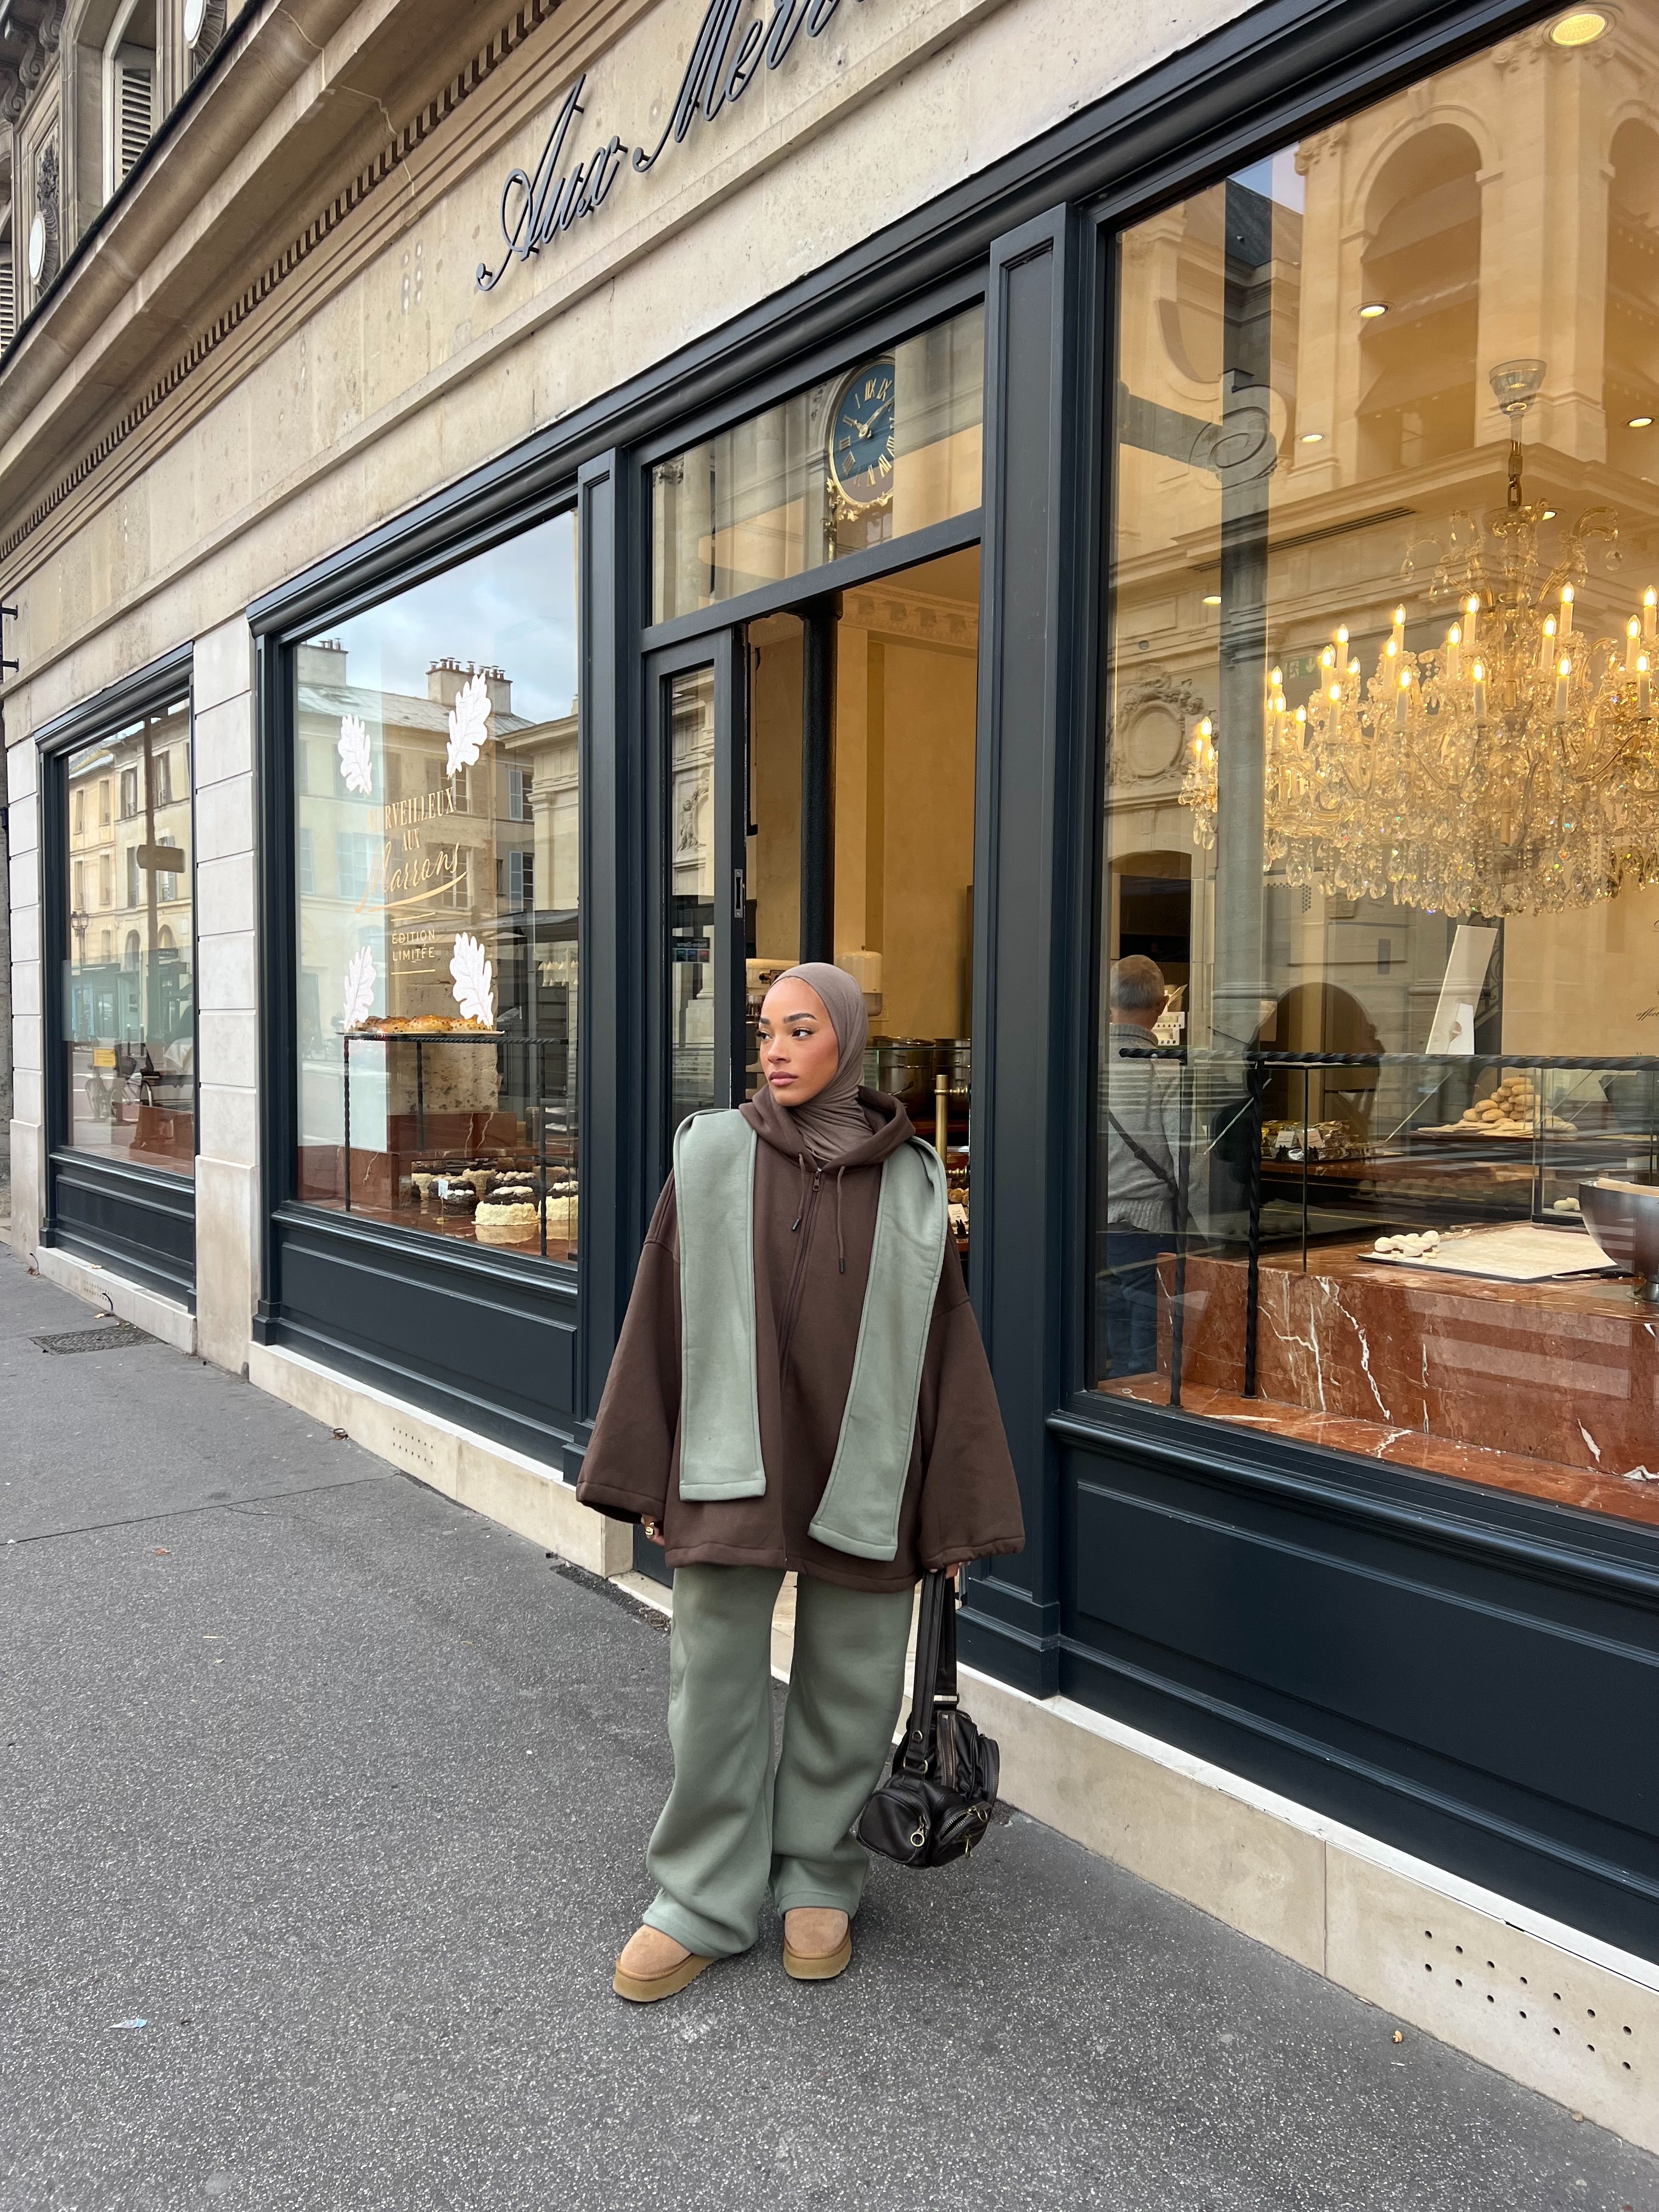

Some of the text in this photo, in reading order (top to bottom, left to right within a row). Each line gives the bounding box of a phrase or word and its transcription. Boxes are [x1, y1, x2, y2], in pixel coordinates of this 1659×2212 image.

[476, 74, 620, 291] Aux
[402, 827, 421, 852] AUX
[354, 842, 460, 913] Marrons
[392, 929, 435, 944] ÉDITION
[392, 944, 435, 961] LIMITÉE
